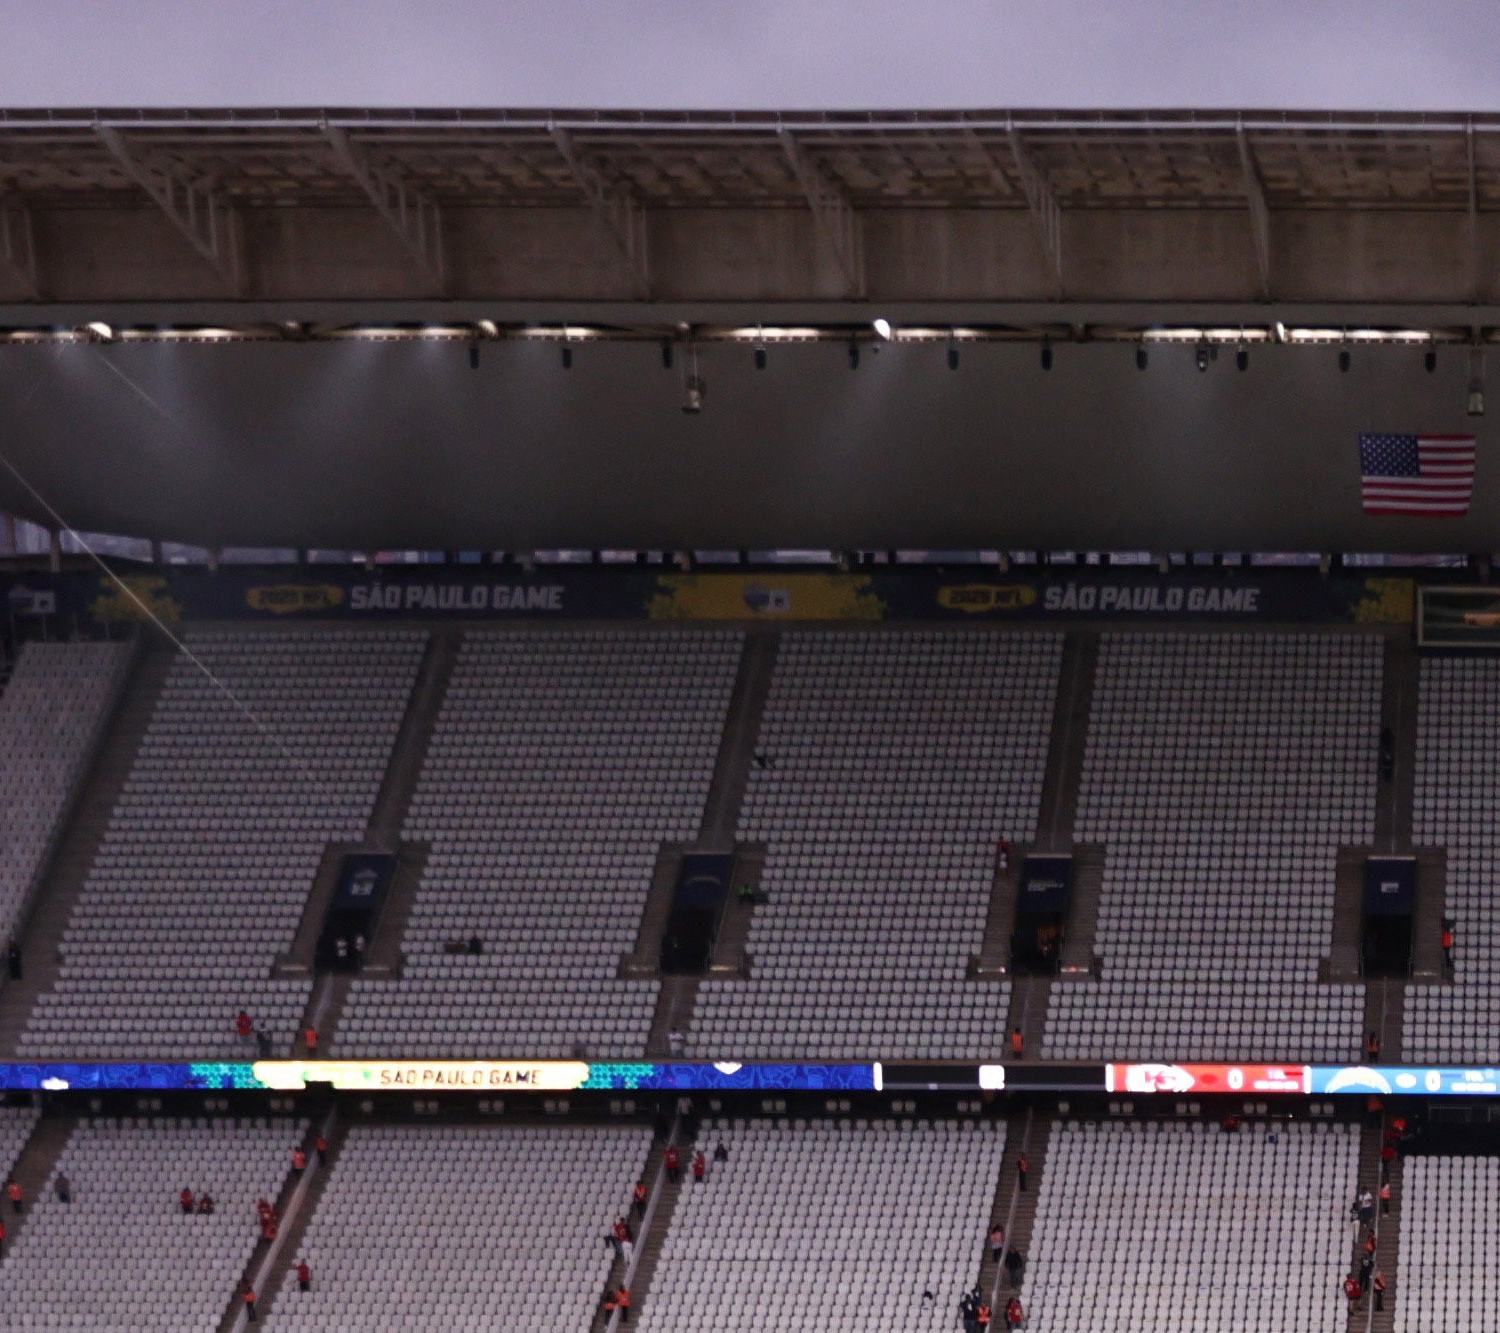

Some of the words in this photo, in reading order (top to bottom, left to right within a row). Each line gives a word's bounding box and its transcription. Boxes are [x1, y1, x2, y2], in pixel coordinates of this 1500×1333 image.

[350, 582, 402, 609] SÃO
[405, 585, 487, 609] PAULO
[493, 585, 565, 610] GAME
[1044, 583, 1096, 611] SÃO
[1100, 587, 1182, 612] PAULO
[1187, 587, 1259, 612] GAME
[422, 1069, 484, 1085] PAULO
[489, 1069, 542, 1085] GAME
[1227, 1069, 1244, 1090] 0
[1424, 1070, 1441, 1091] 0
